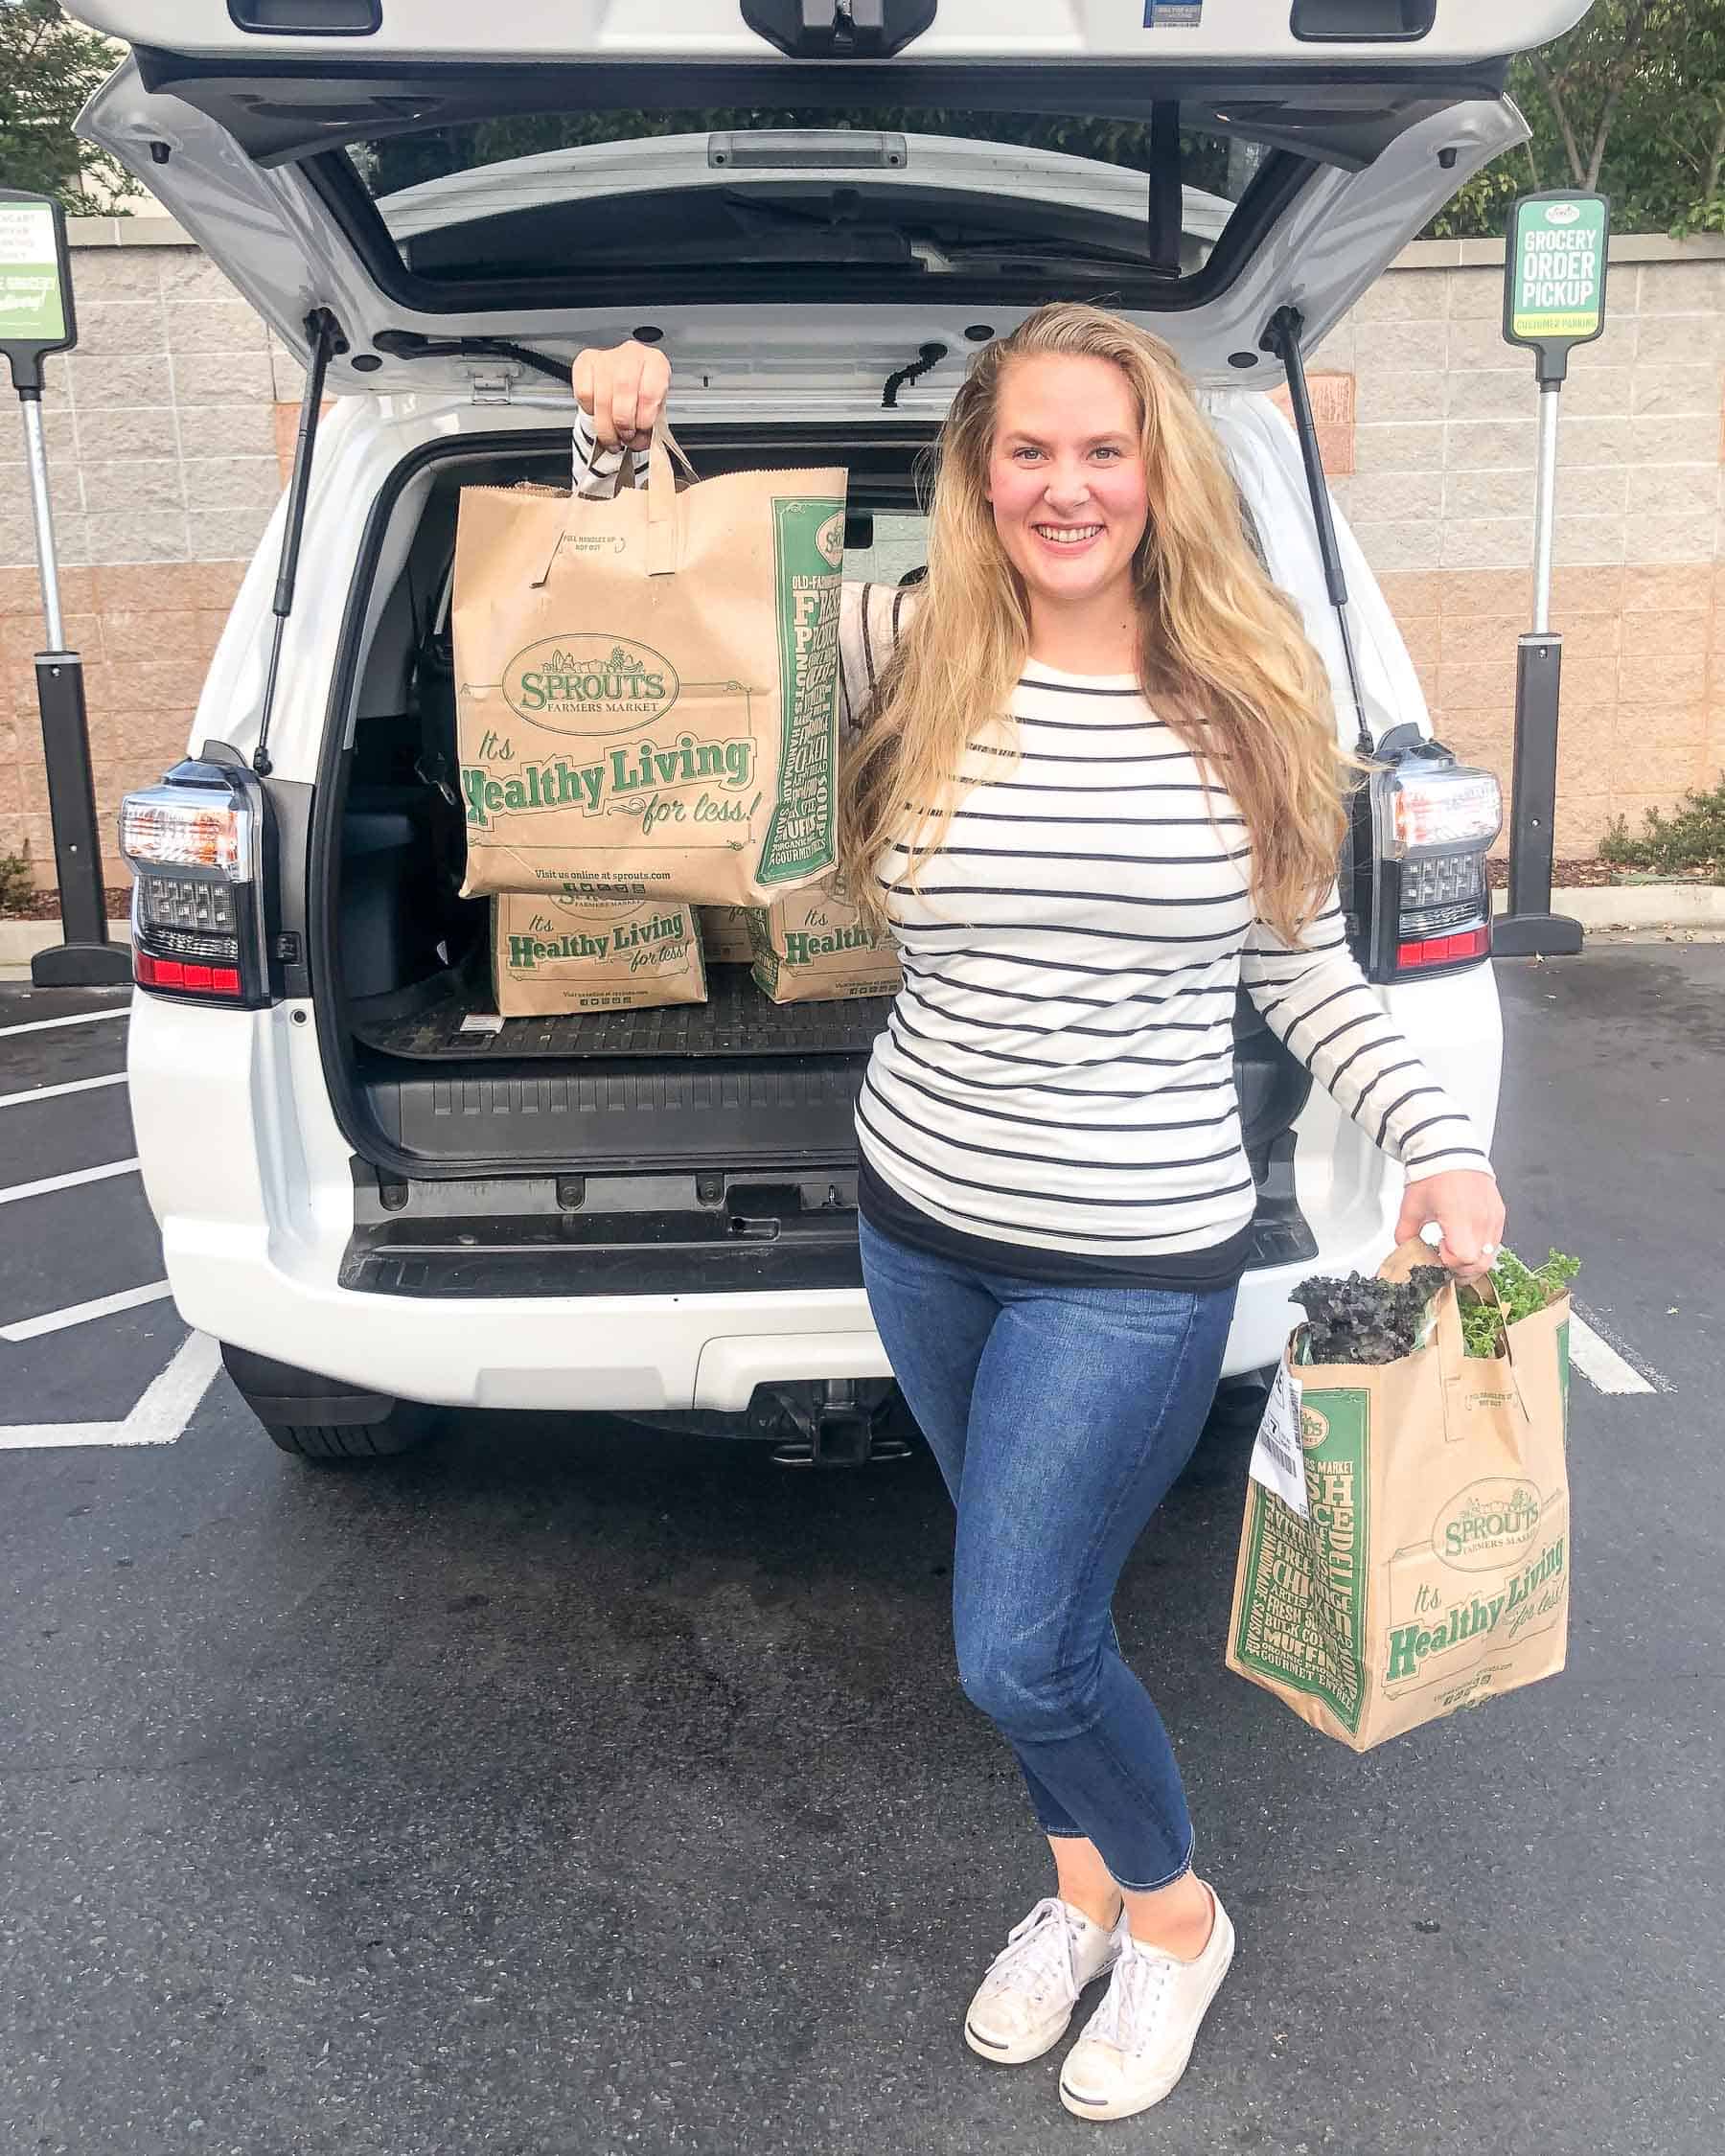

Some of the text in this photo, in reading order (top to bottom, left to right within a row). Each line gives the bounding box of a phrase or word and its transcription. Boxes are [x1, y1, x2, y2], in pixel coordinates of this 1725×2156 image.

[1525, 230, 1597, 252] GROCERY
[1524, 250, 1595, 282] ORDER
[1522, 280, 1594, 308] PICKUP
[520, 673, 666, 710] SPROUTS
[547, 702, 659, 713] FARMERS MARKET
[611, 737, 750, 792] Living
[641, 791, 763, 836] for less!
[816, 774, 828, 837] SOUP
[536, 869, 558, 879] Visit
[570, 870, 600, 880] online
[612, 872, 671, 882] sprouts.com
[509, 914, 684, 967] Healthy Living
[631, 949, 657, 973] for
[658, 939, 690, 962] less!
[1317, 1461, 1353, 1475] MARKET
[1445, 1505, 1539, 1557] SPROUTS
[1254, 1531, 1276, 1603] HANDMADE
[1327, 1530, 1354, 1596] DELI
[1265, 1611, 1301, 1638] BULK
[1266, 1593, 1302, 1624] FRESH
[1387, 1595, 1505, 1681] Healthy
[1505, 1537, 1564, 1614] Living
[1261, 1651, 1316, 1682] GOURMET
[1264, 1626, 1344, 1679] MUFFIN
